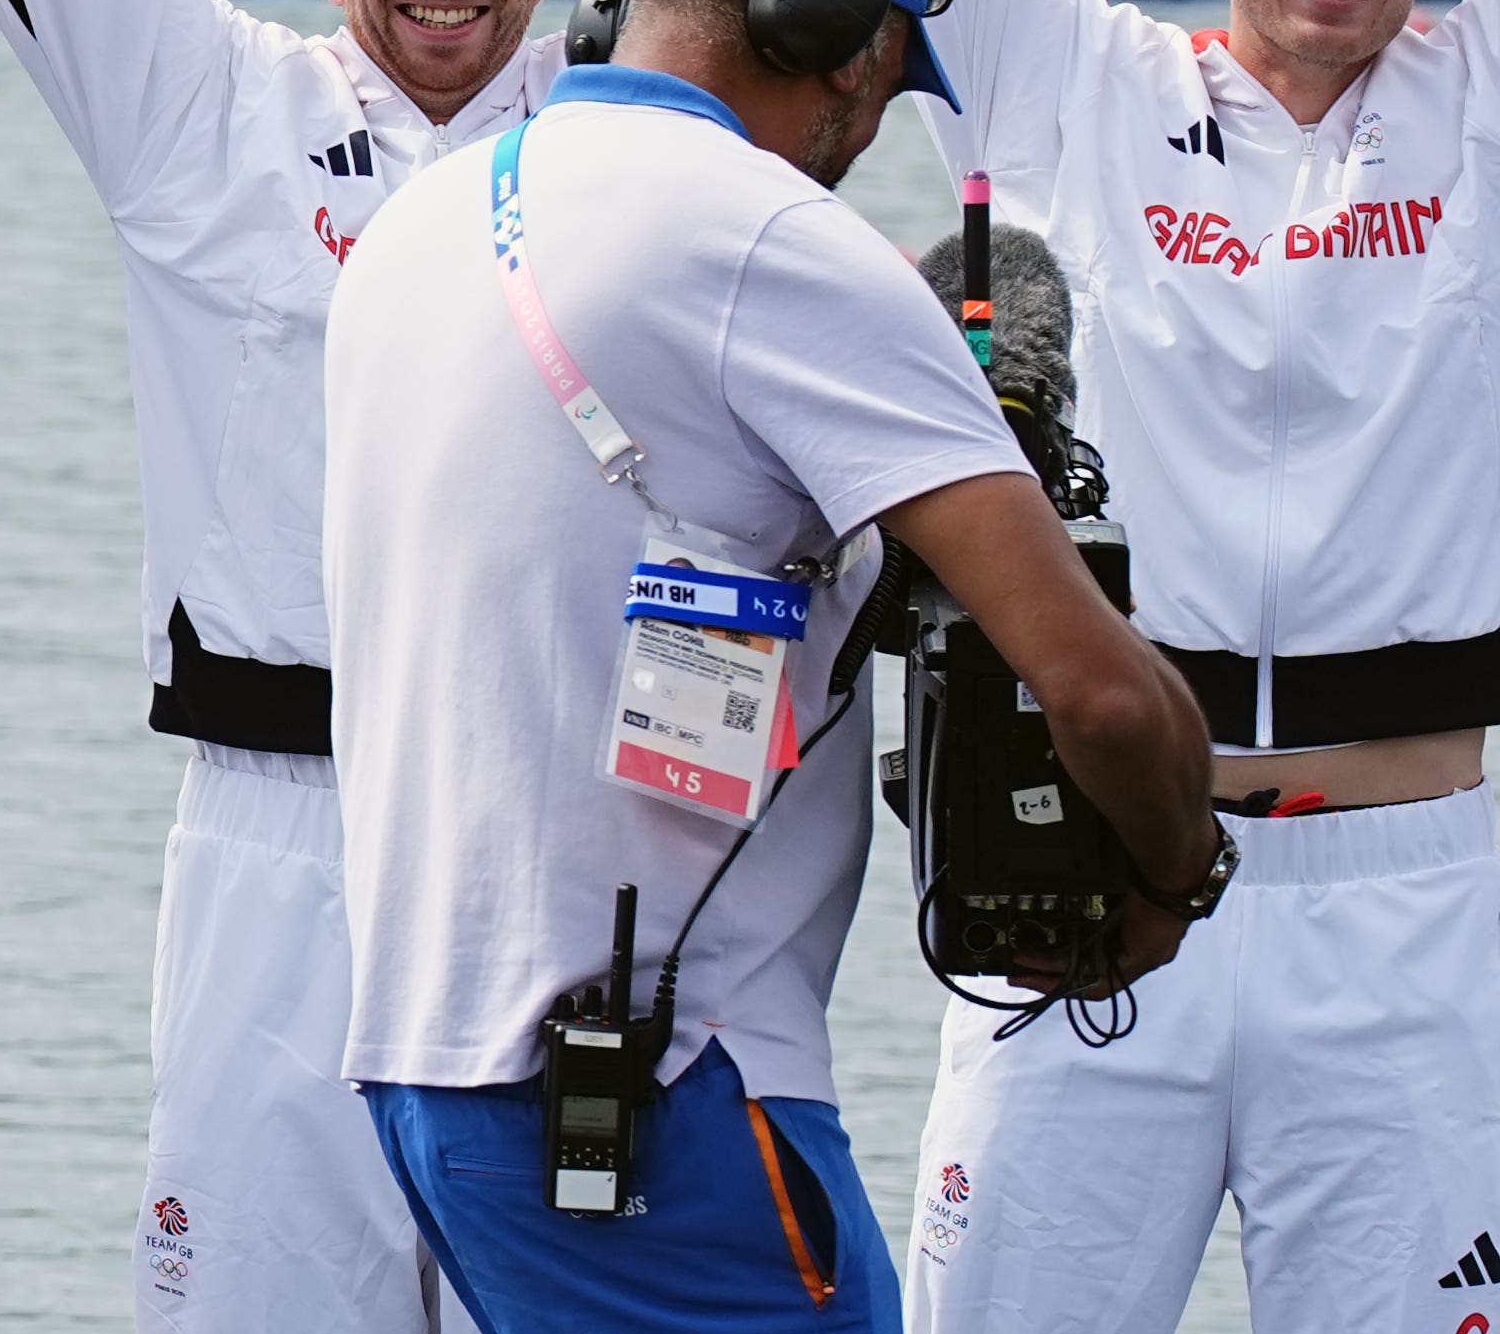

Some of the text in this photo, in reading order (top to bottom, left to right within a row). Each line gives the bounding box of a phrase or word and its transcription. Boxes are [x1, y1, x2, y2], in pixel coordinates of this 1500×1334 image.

[1363, 112, 1382, 124] GB
[531, 330, 575, 392] PARIS
[640, 619, 670, 636] Adam
[654, 722, 673, 735] IBC
[678, 728, 702, 744] MPC
[615, 1195, 648, 1217] BS
[925, 1197, 969, 1229] TEAM GB
[145, 1235, 193, 1259] TEAM GB
